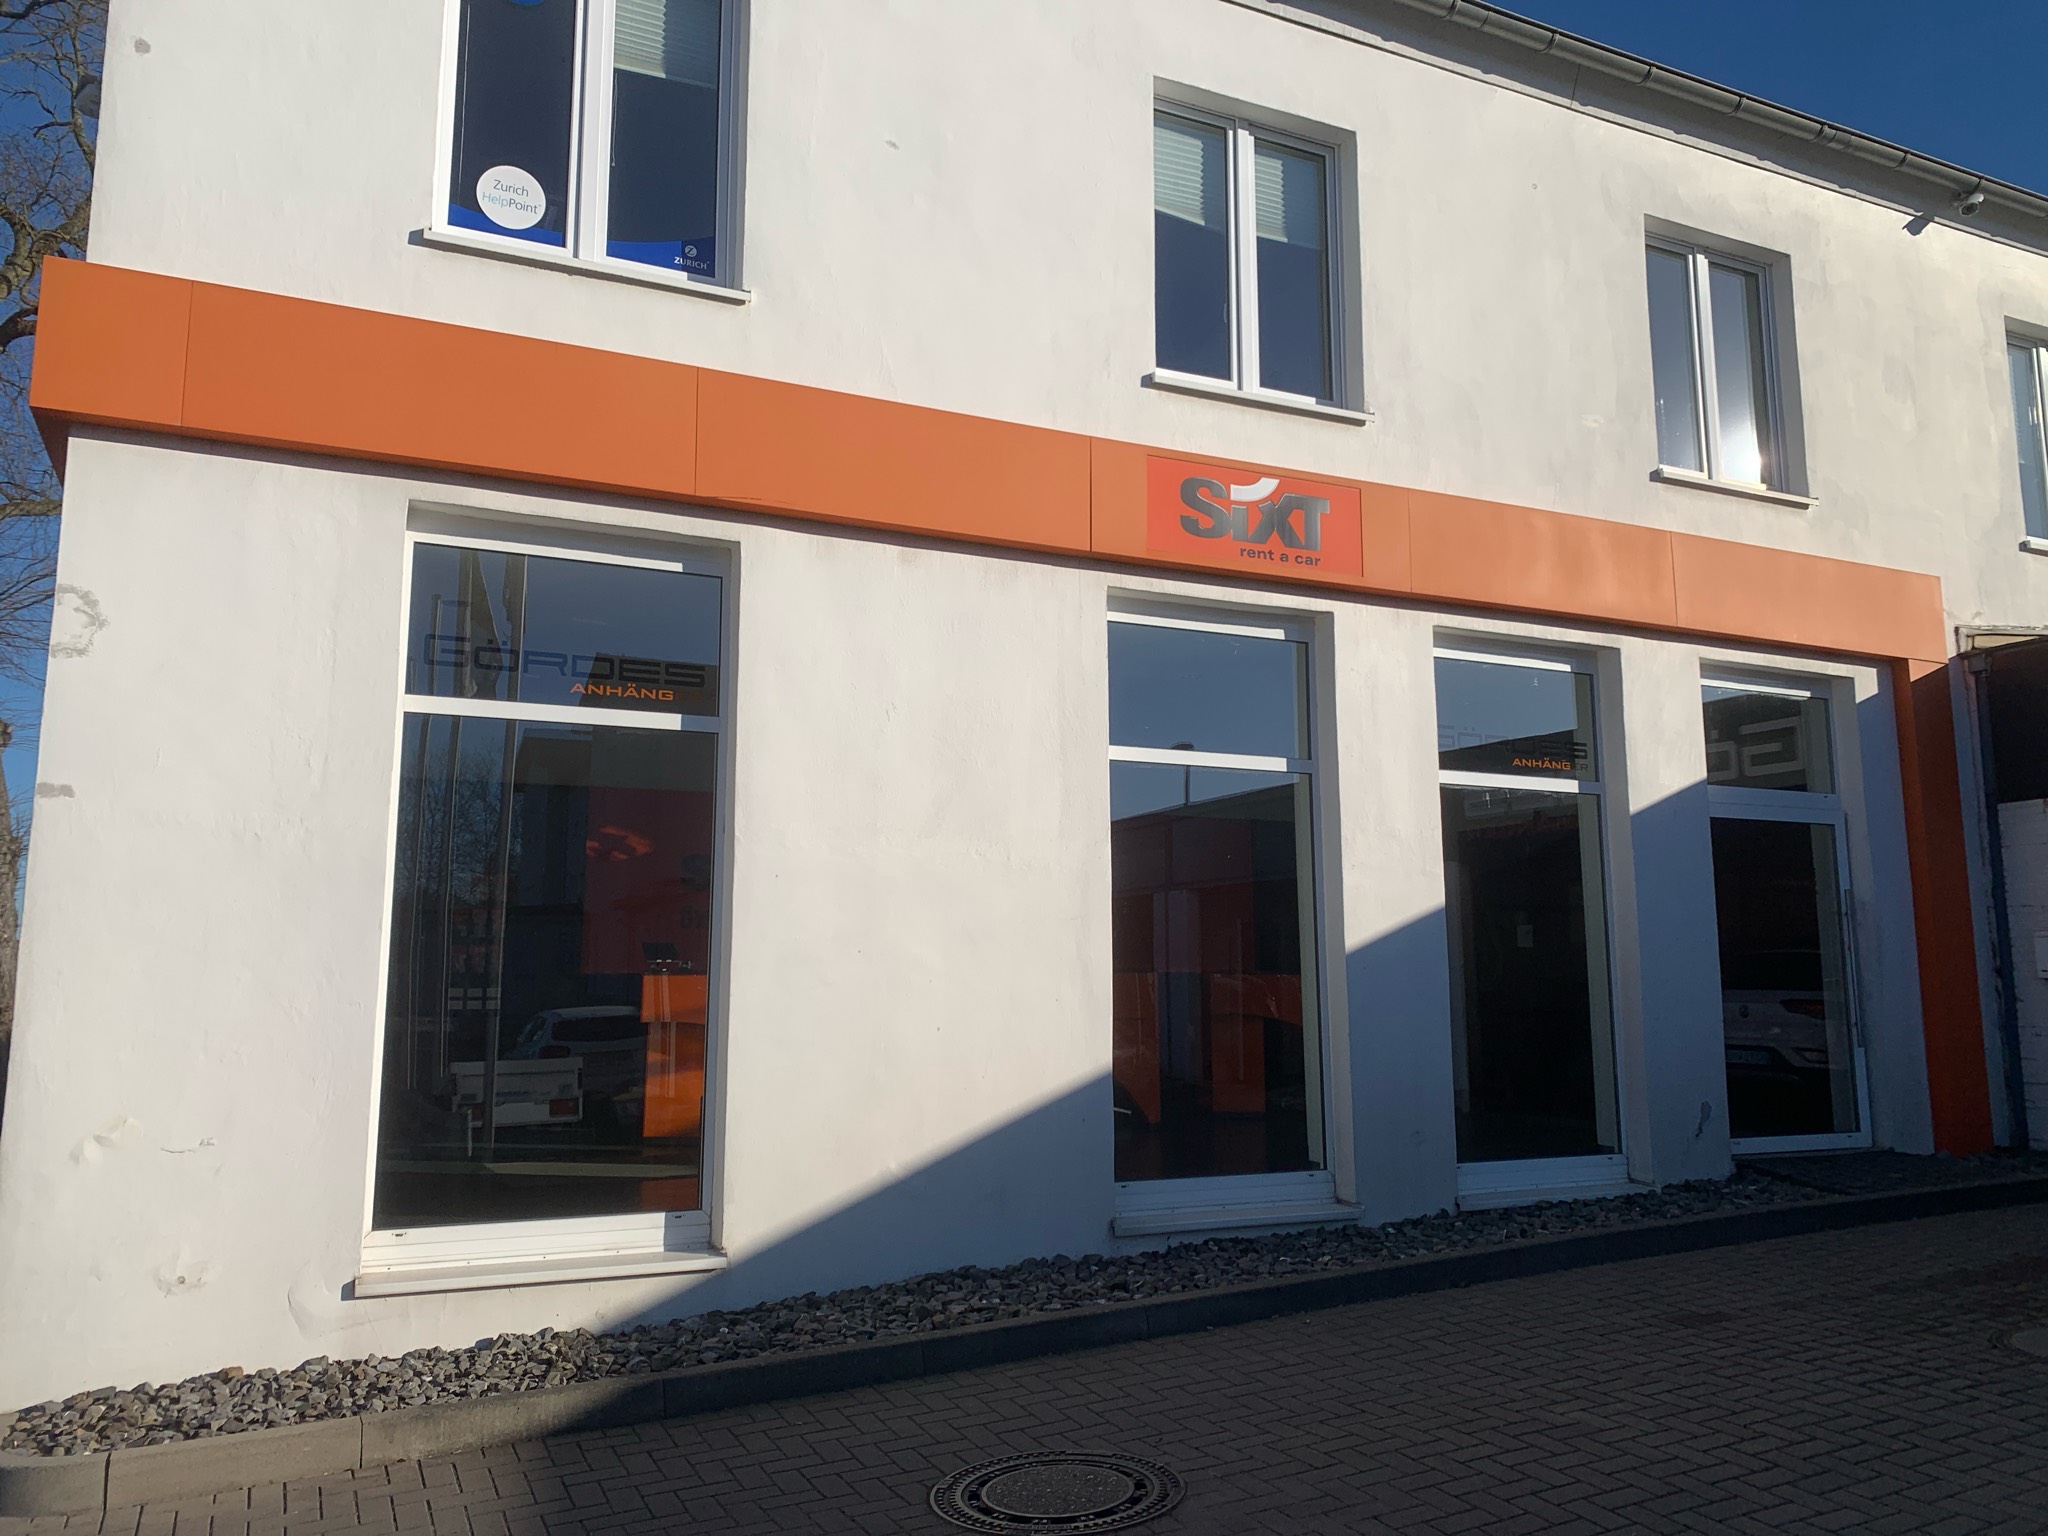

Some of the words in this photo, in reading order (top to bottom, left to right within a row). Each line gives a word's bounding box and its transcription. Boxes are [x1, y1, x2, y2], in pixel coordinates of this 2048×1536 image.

[493, 179, 529, 197] Zurich
[482, 191, 539, 215] HelpPoint
[674, 256, 708, 270] ZURICH
[1240, 547, 1274, 561] rent
[1280, 553, 1289, 563] a
[1295, 554, 1321, 567] car
